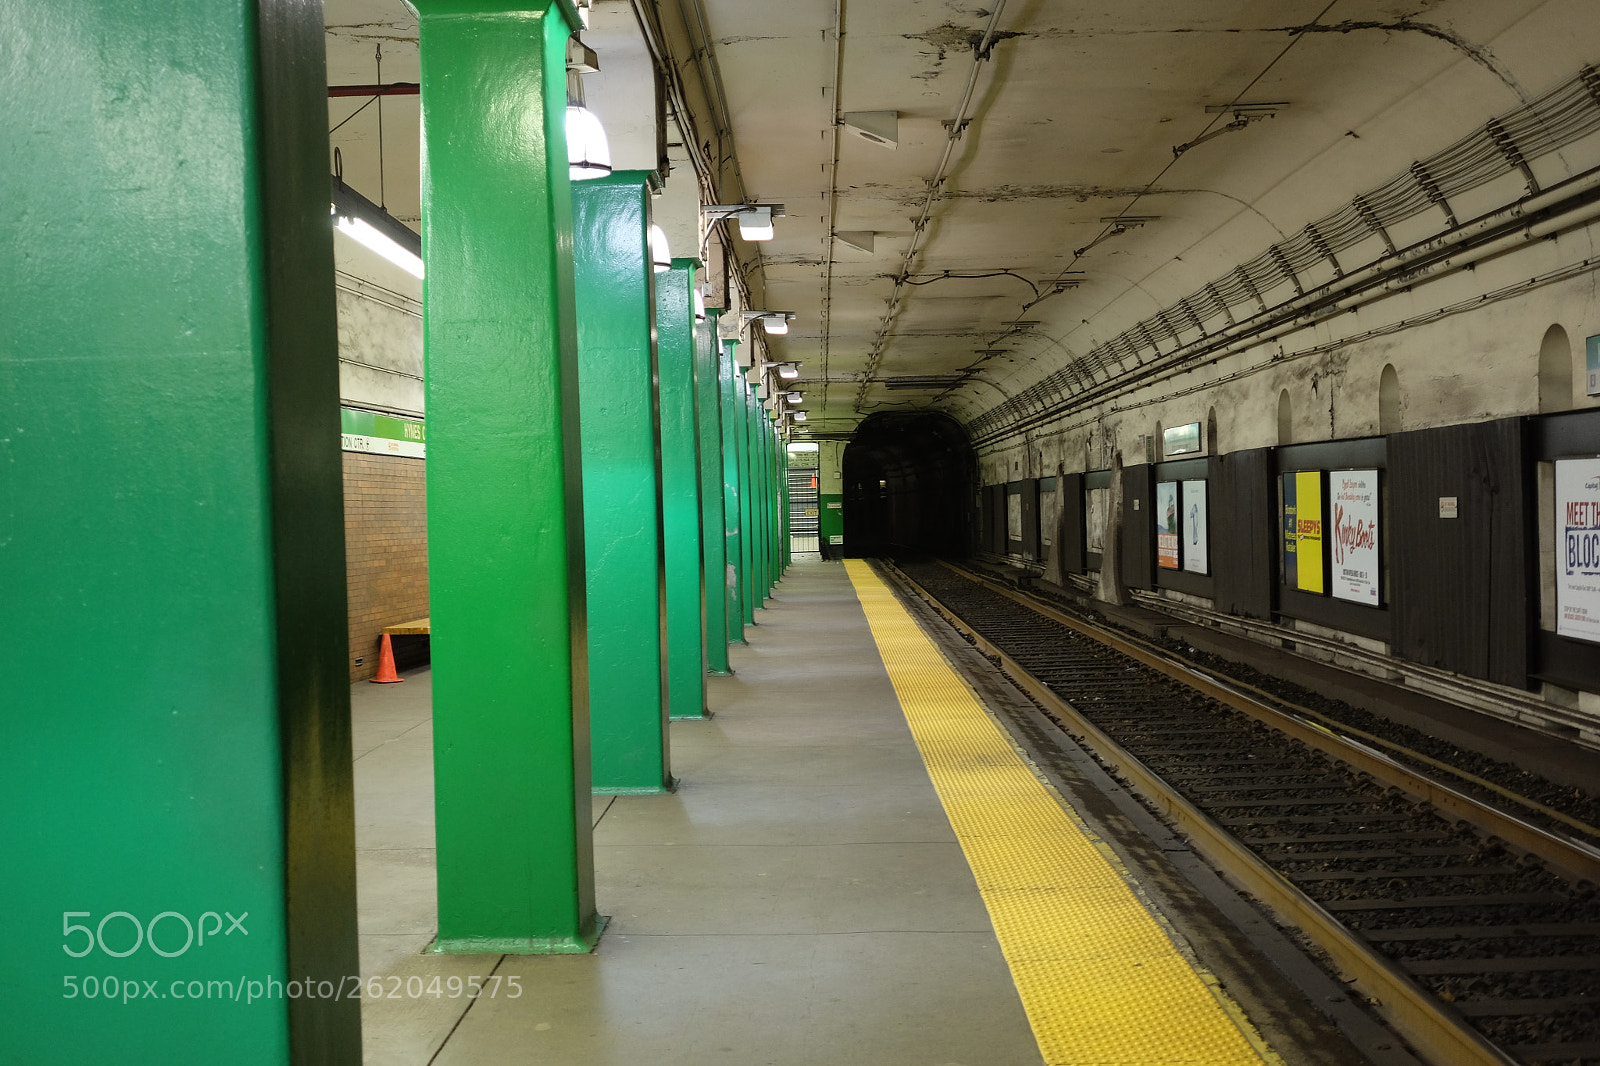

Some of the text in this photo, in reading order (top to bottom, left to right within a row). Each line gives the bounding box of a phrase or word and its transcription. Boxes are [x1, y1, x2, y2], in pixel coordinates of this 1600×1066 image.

[404, 423, 421, 440] HYNES
[1566, 501, 1590, 526] MEET
[1334, 502, 1376, 566] Kinky Boots
